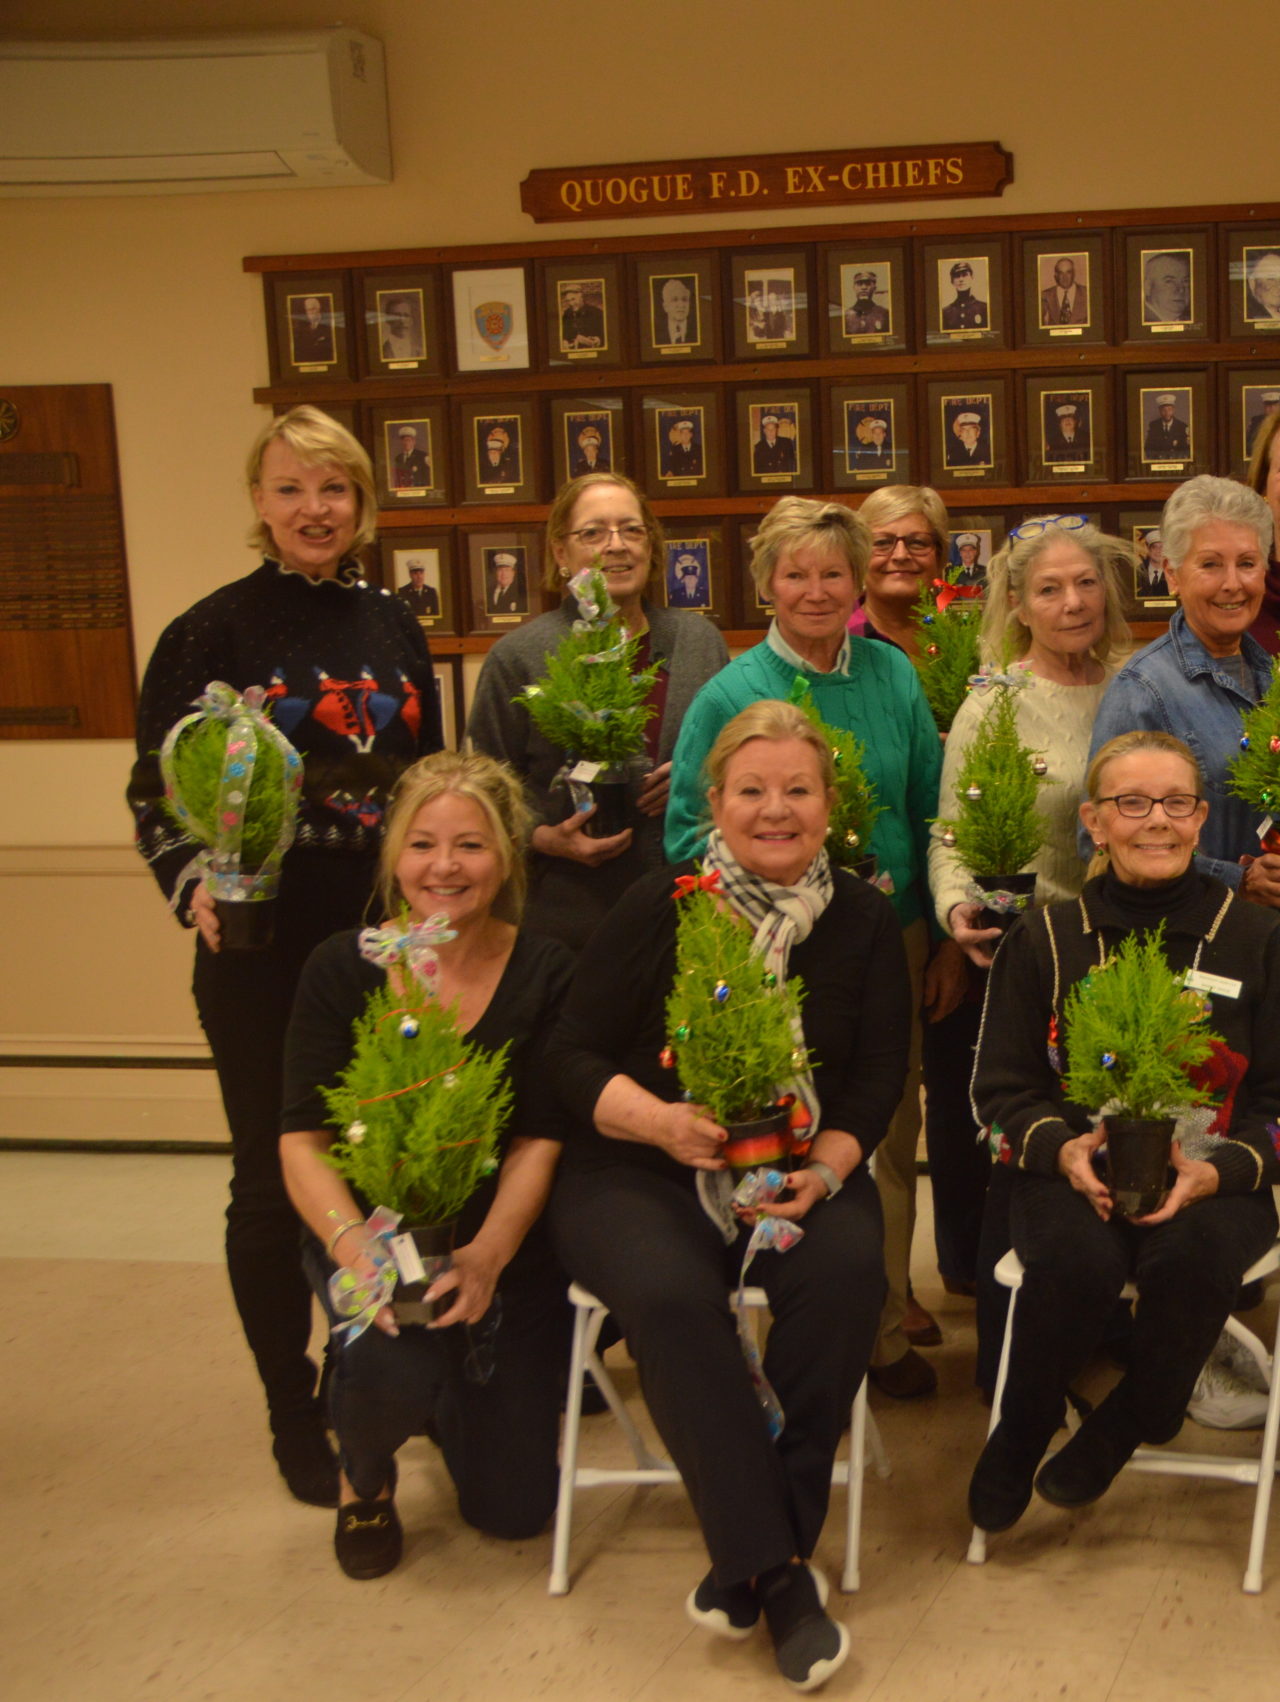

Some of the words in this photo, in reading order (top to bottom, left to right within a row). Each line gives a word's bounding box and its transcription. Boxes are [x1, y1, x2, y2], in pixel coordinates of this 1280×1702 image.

[560, 174, 694, 212] QUOGUE
[709, 169, 769, 199] F.D.
[785, 157, 964, 195] EX-CHIEFS
